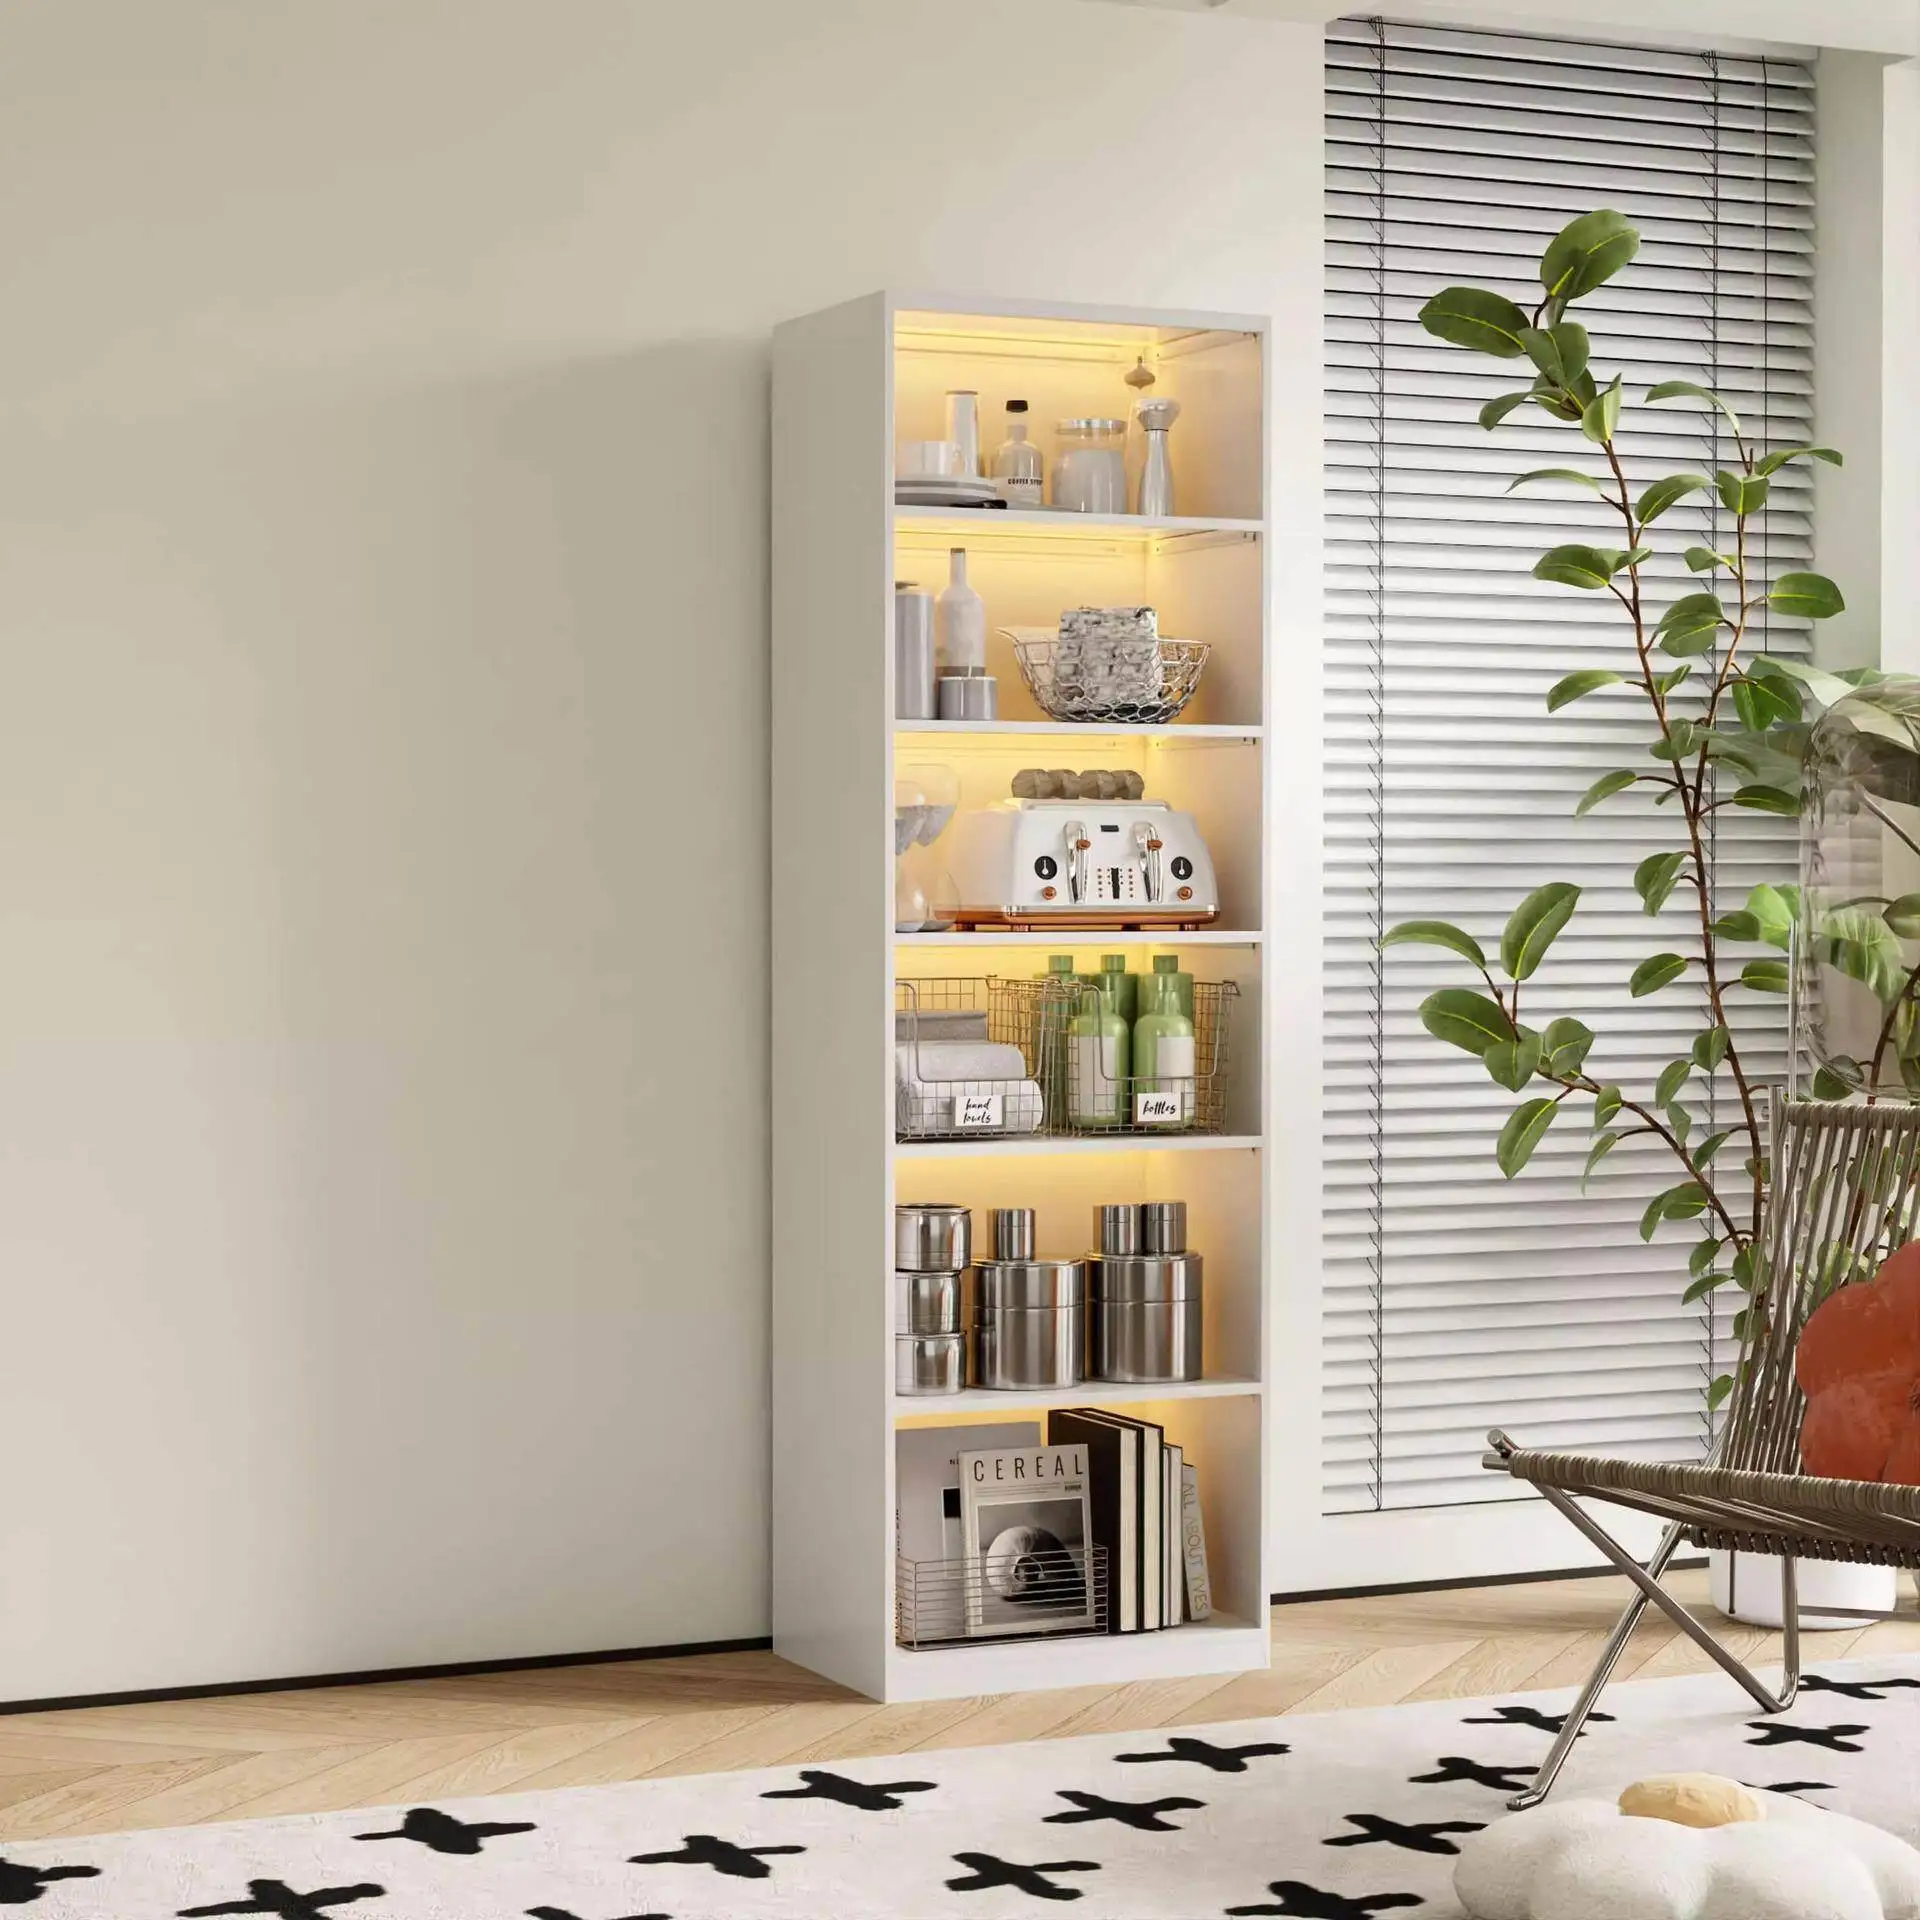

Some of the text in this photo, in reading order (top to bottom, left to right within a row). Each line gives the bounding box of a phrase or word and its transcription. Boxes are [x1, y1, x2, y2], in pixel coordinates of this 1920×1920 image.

[966, 1098, 991, 1110] hand
[1142, 1100, 1176, 1115] bottles
[974, 1453, 1083, 1481] CEREAL
[1183, 1483, 1208, 1612] ALL ABOUT YVES
